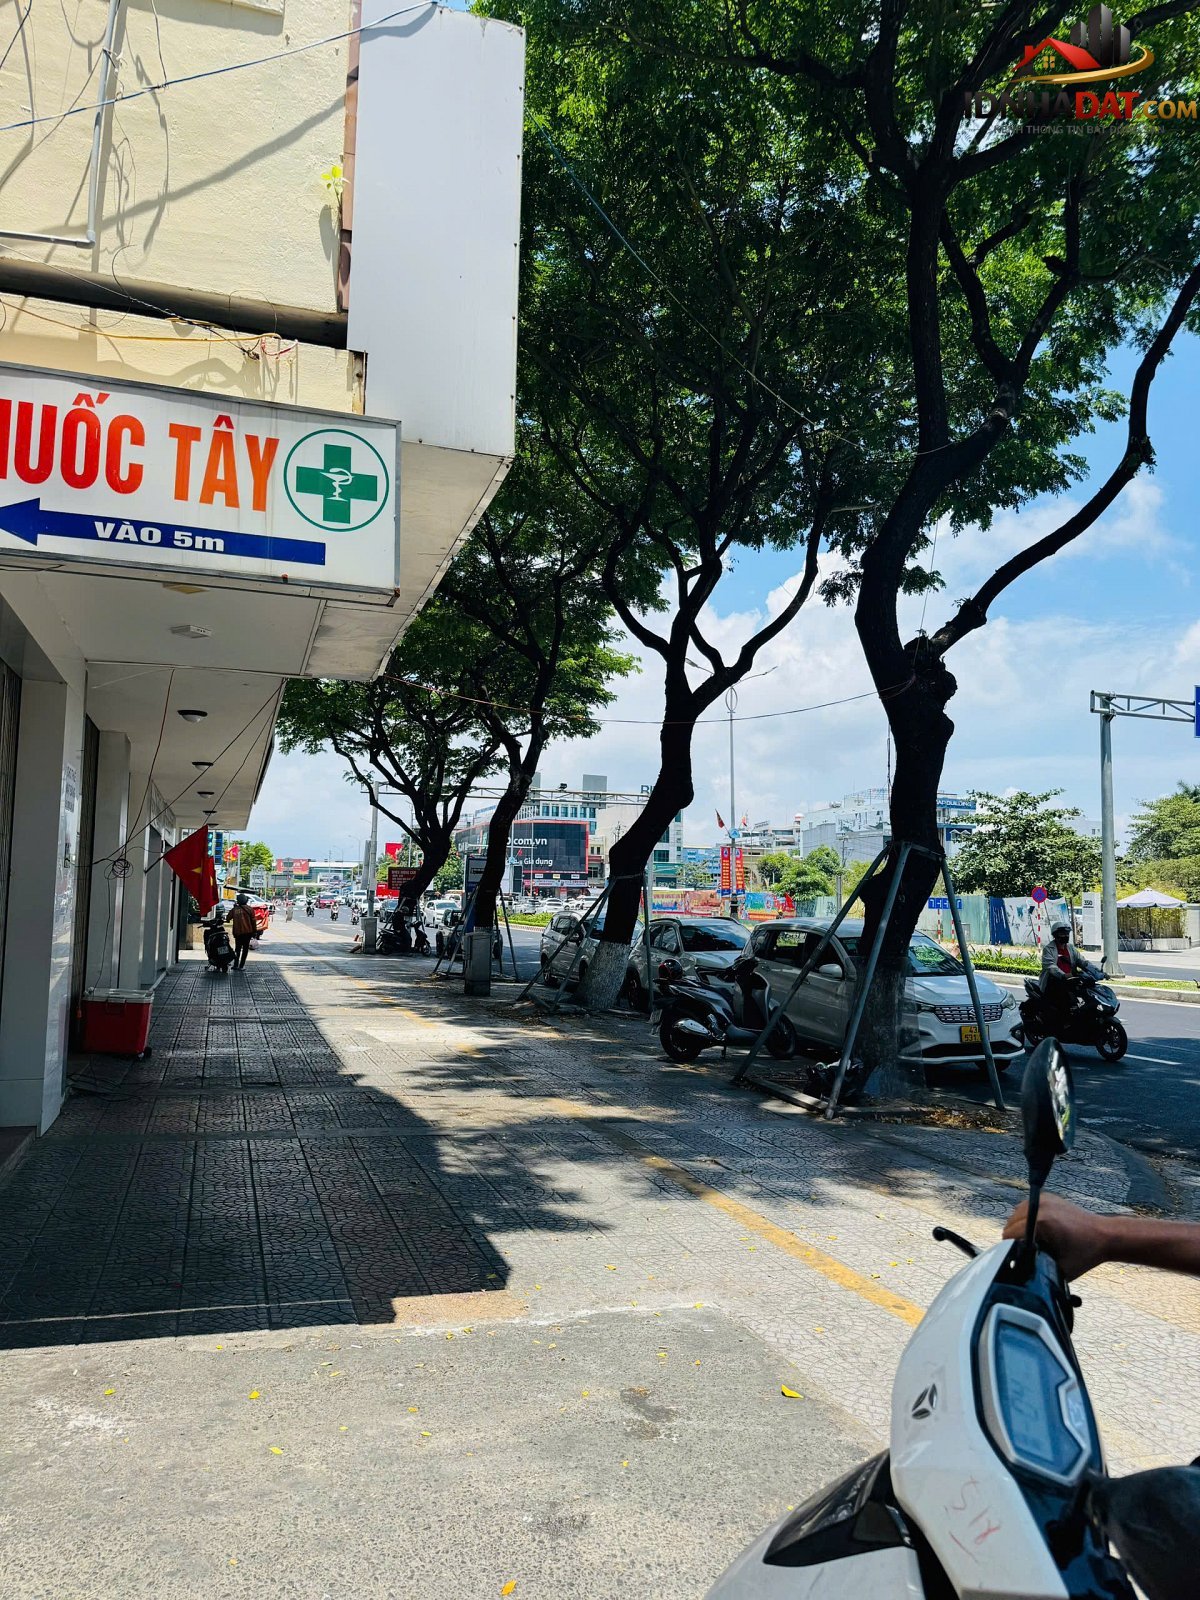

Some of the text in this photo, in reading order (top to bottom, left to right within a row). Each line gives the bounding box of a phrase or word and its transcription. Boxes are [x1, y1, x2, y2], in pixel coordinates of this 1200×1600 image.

[168, 414, 280, 513] TÂY
[94, 520, 225, 553] VÀO 5m
[535, 857, 553, 867] dụng
